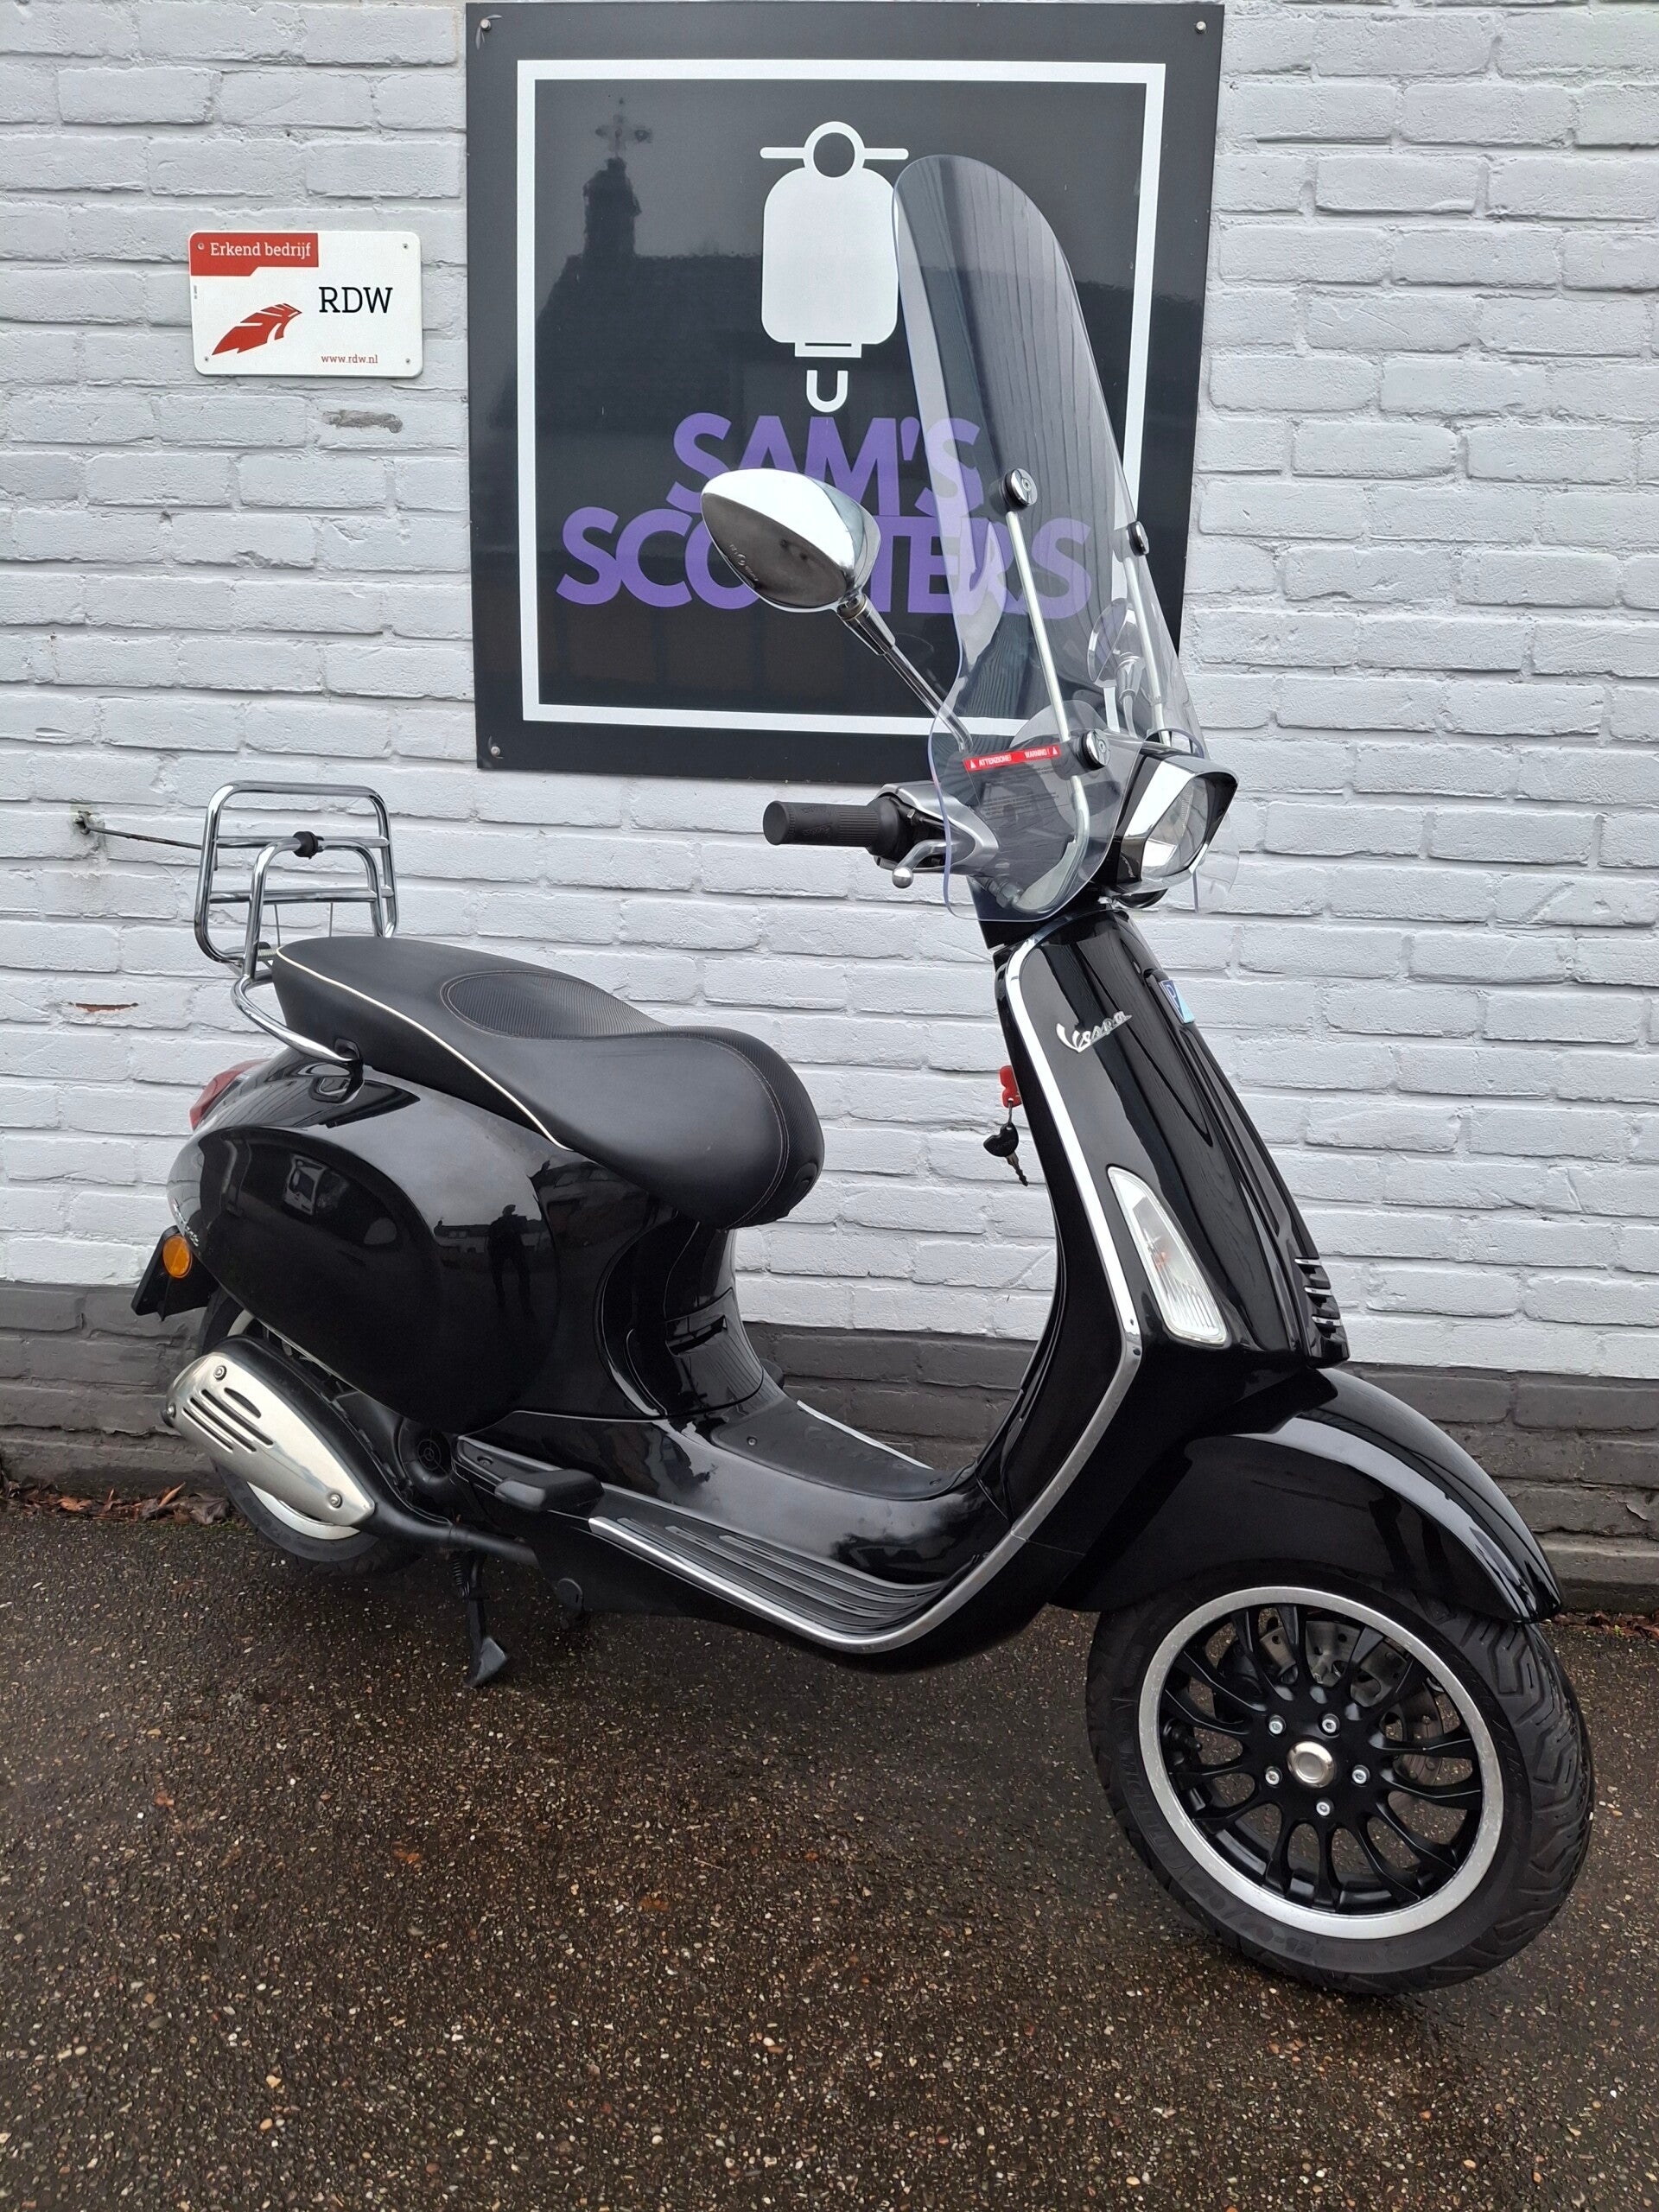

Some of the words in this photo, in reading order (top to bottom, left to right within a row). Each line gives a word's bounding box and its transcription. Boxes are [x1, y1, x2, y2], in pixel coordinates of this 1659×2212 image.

[210, 242, 261, 256] Erkend
[264, 242, 311, 259] bedrijf
[318, 286, 393, 314] RDW
[321, 354, 378, 365] www.rdw.nl
[556, 505, 1091, 619] SCOTERS
[1056, 1010, 1132, 1052] Vespa
